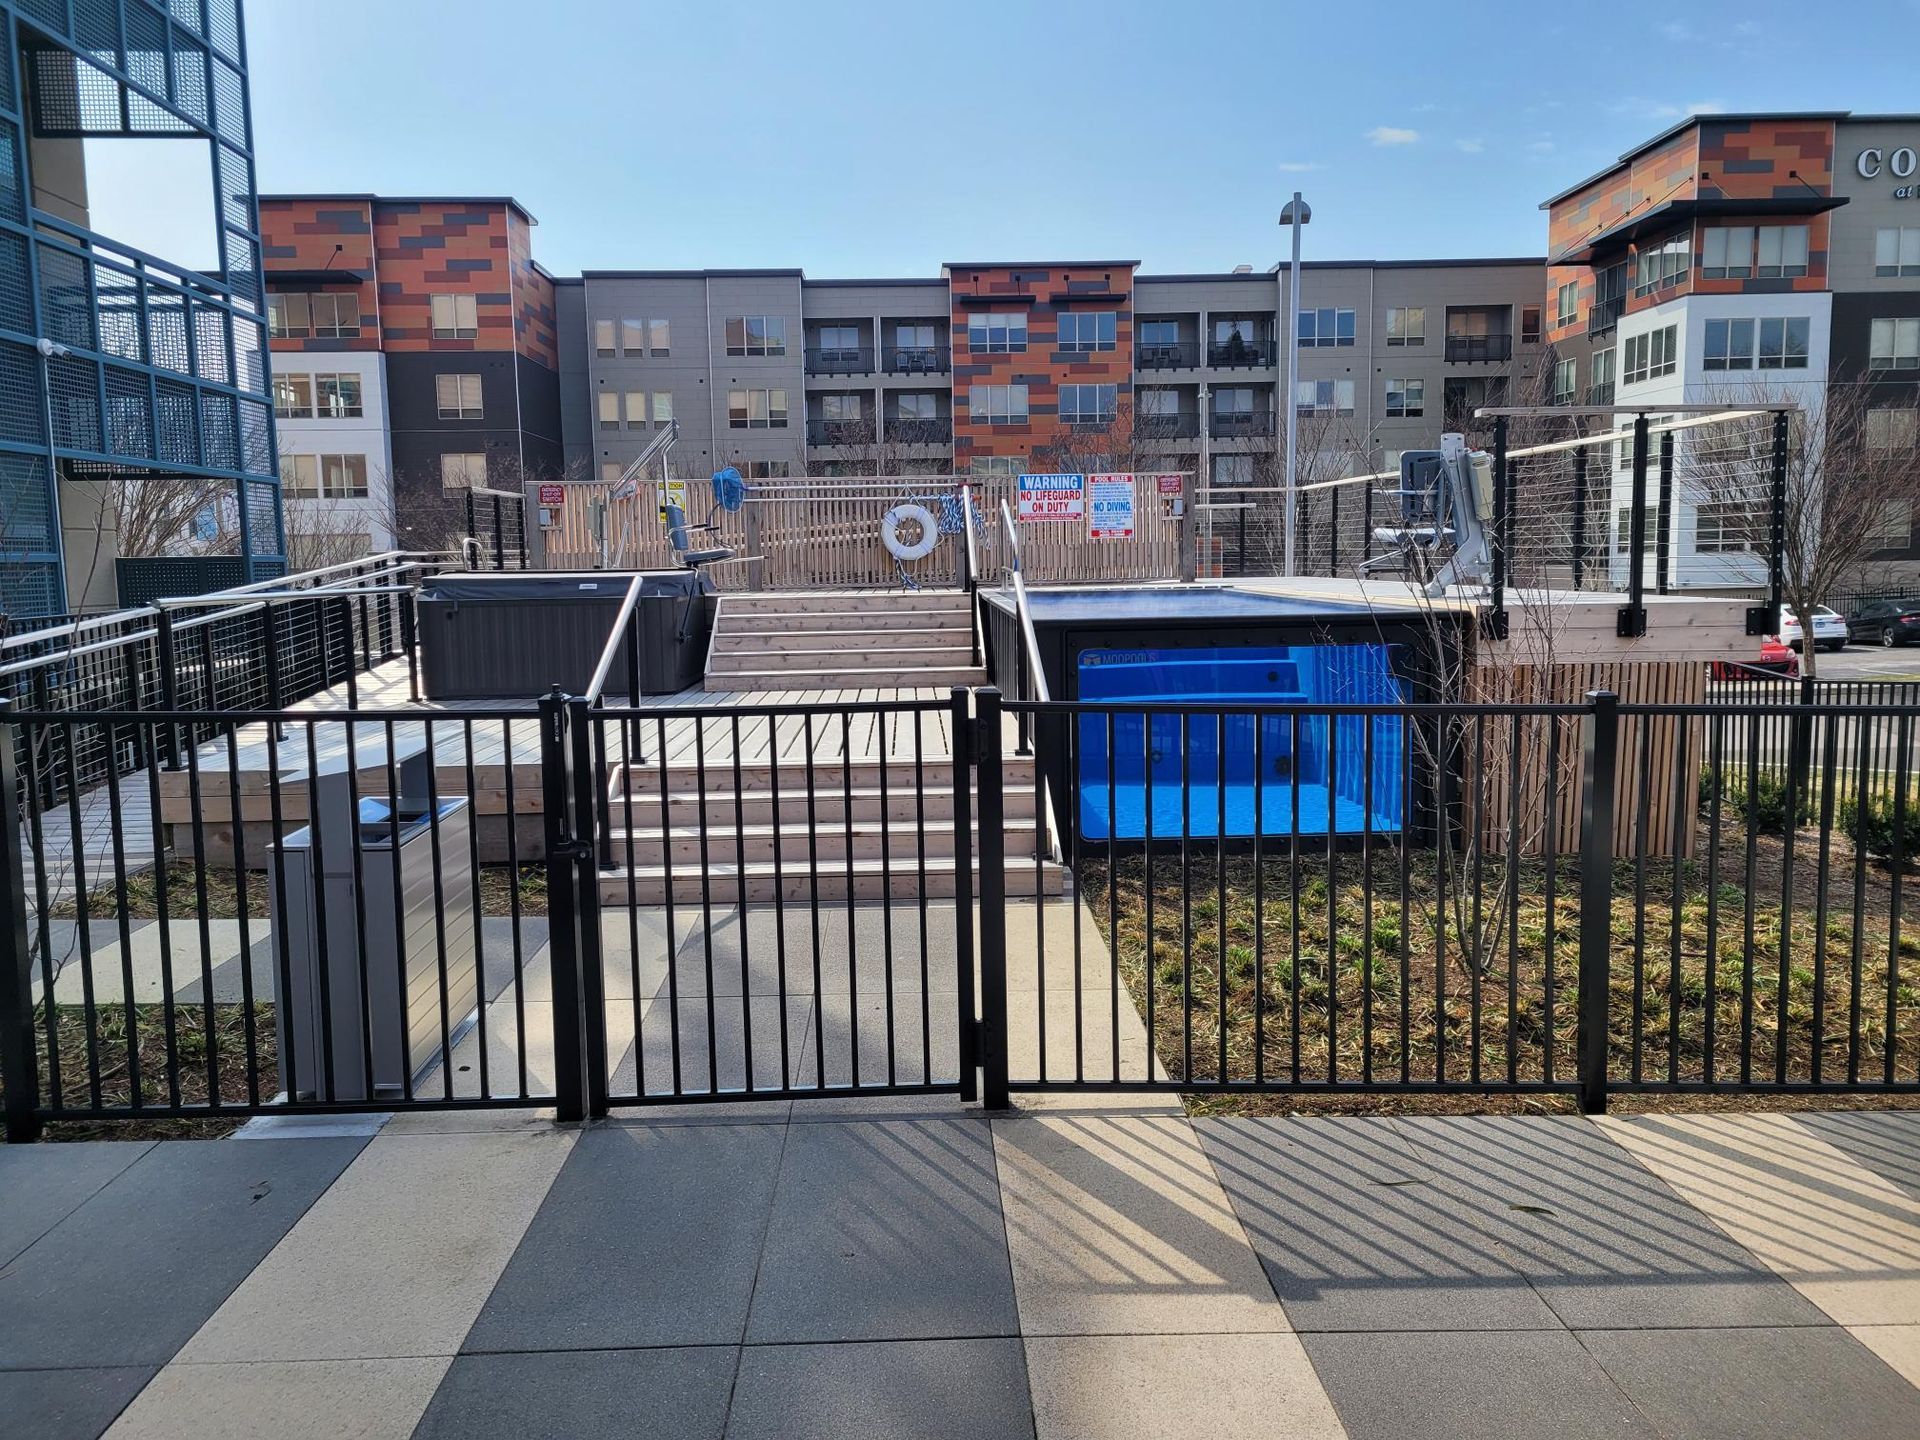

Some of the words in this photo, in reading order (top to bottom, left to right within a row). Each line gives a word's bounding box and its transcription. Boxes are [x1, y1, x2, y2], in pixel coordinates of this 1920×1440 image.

[1024, 476, 1078, 489] WARNING
[1020, 490, 1032, 501] NO
[1035, 490, 1081, 501] LIFEGUARD
[1032, 501, 1044, 512] ON
[1047, 501, 1069, 512] DUTY
[1094, 502, 1104, 511] NO
